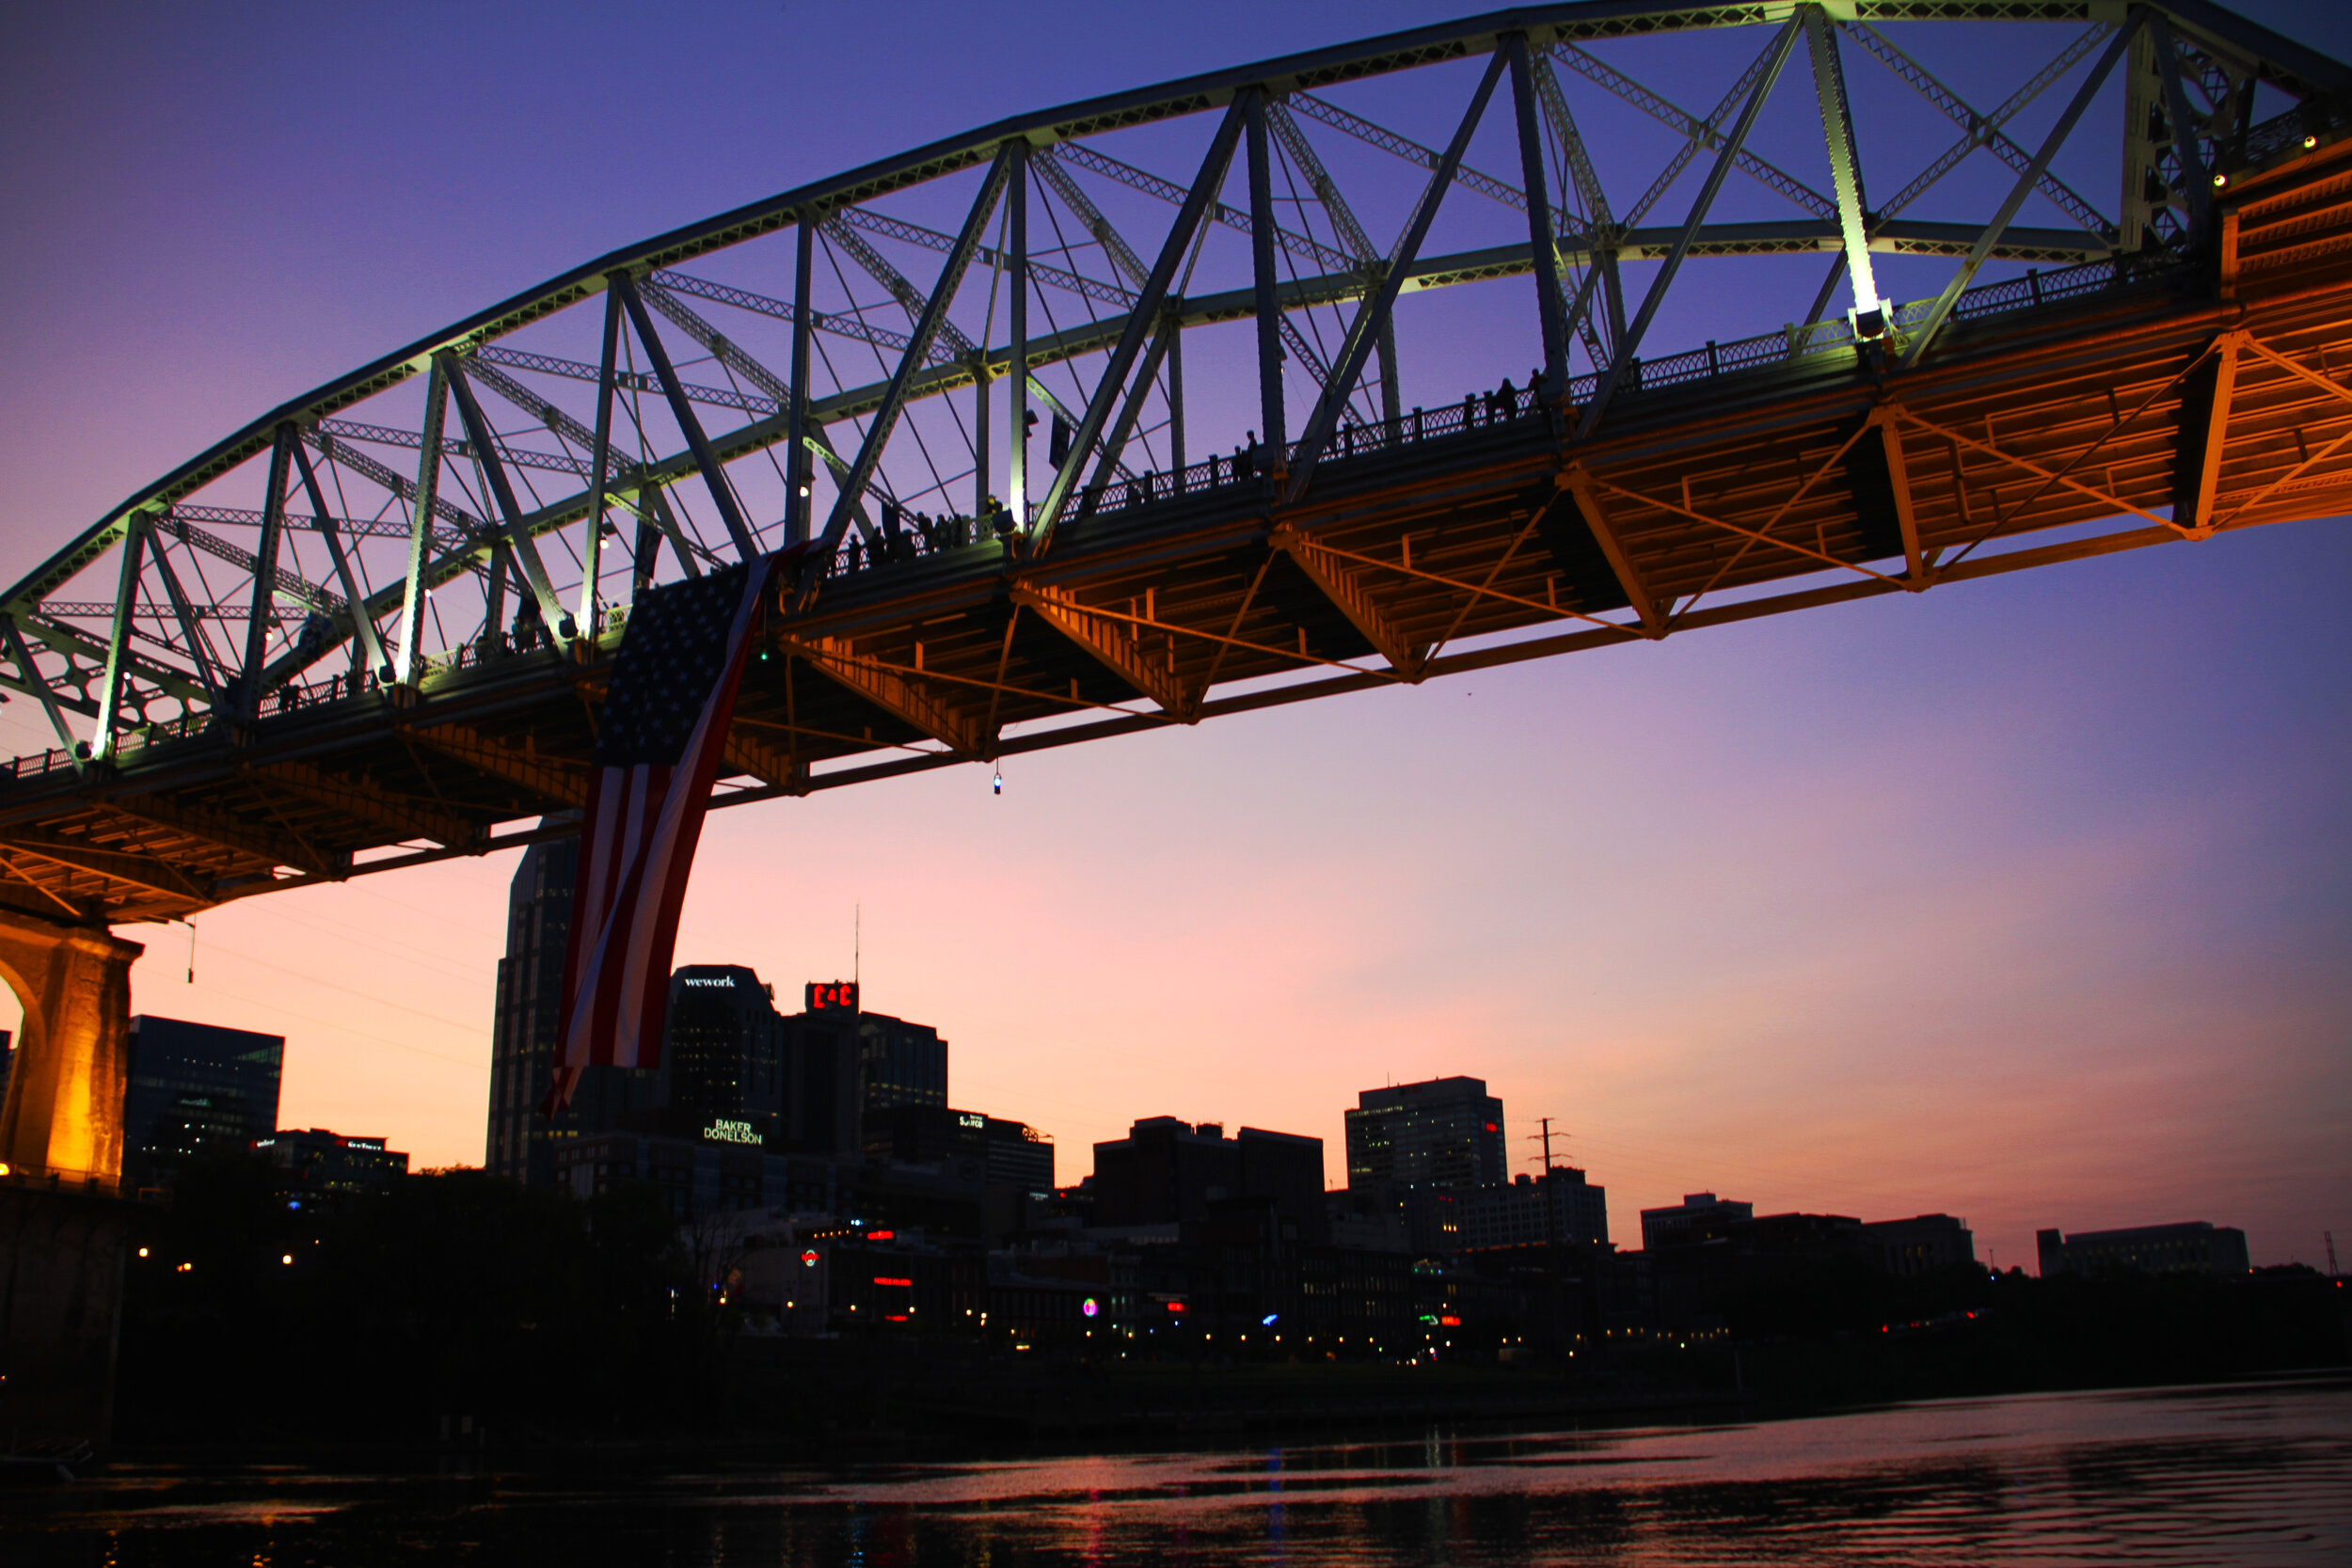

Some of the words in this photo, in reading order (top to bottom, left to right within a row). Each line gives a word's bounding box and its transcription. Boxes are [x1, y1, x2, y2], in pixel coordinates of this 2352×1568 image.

[685, 975, 736, 987] wework
[715, 1118, 751, 1133] BAKER
[704, 1127, 762, 1145] DONELSON
